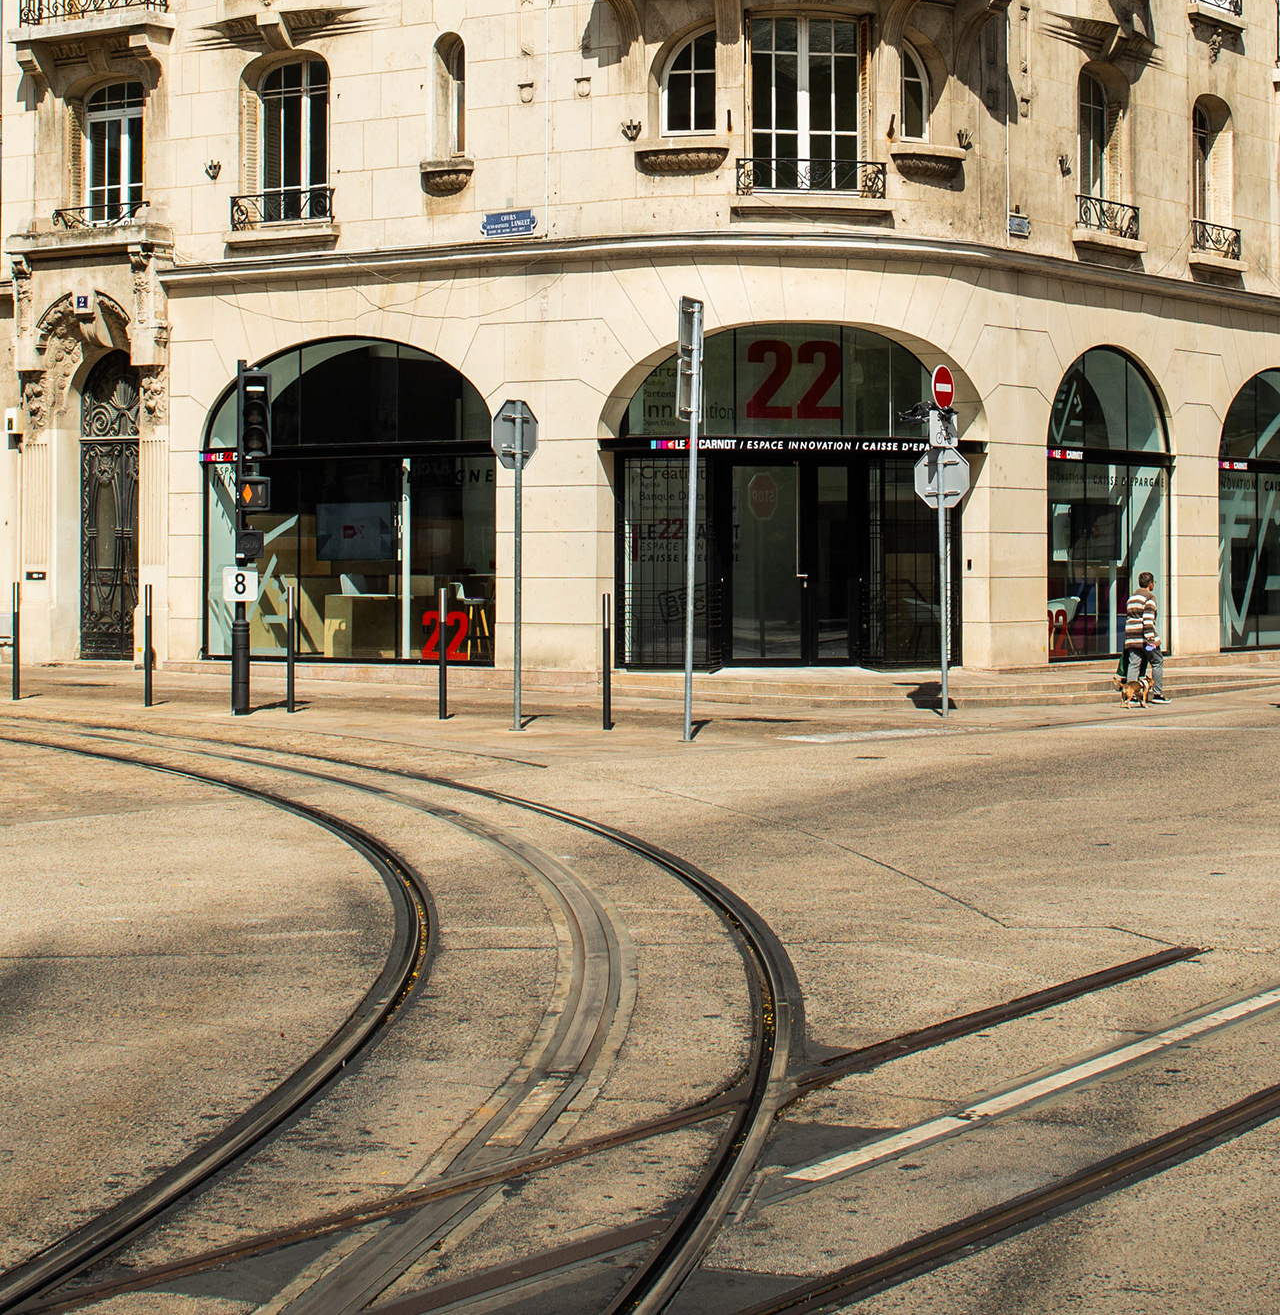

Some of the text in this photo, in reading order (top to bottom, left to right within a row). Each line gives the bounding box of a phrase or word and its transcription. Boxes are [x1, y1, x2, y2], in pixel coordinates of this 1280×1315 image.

[79, 297, 85, 306] 2
[745, 339, 843, 419] 22
[746, 440, 784, 450] ESPACE
[788, 440, 852, 450] INNOVATION
[862, 441, 899, 451] CAISSE
[658, 518, 684, 539] 22
[639, 542, 679, 551] ESPACE
[639, 554, 679, 563] CAISSE
[233, 573, 246, 595] 8
